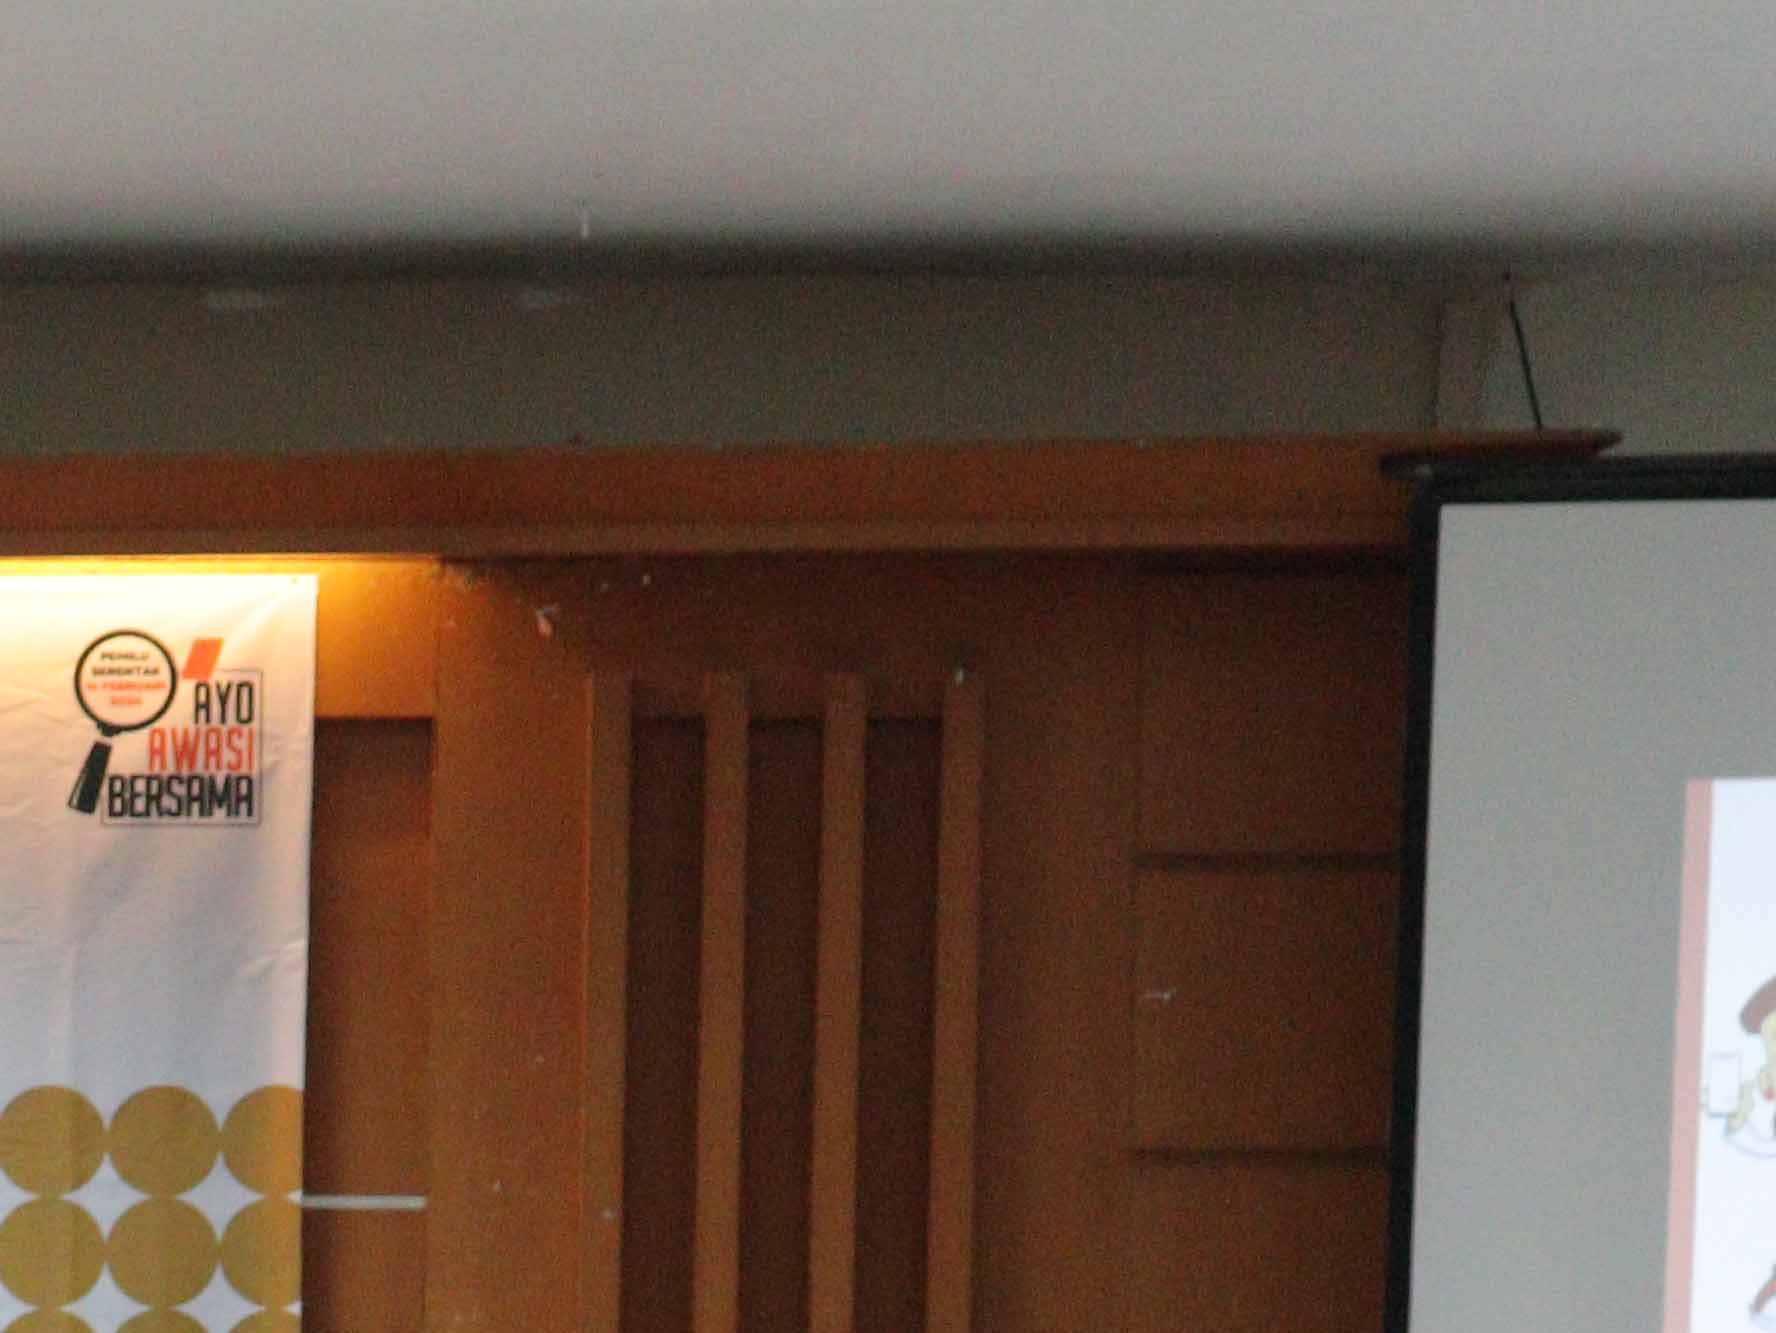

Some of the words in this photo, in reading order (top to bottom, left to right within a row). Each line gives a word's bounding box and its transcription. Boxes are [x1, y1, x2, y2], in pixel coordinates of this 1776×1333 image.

[194, 681, 255, 725] AYO
[148, 726, 256, 773] AWASI
[107, 775, 255, 819] BERSAMA
